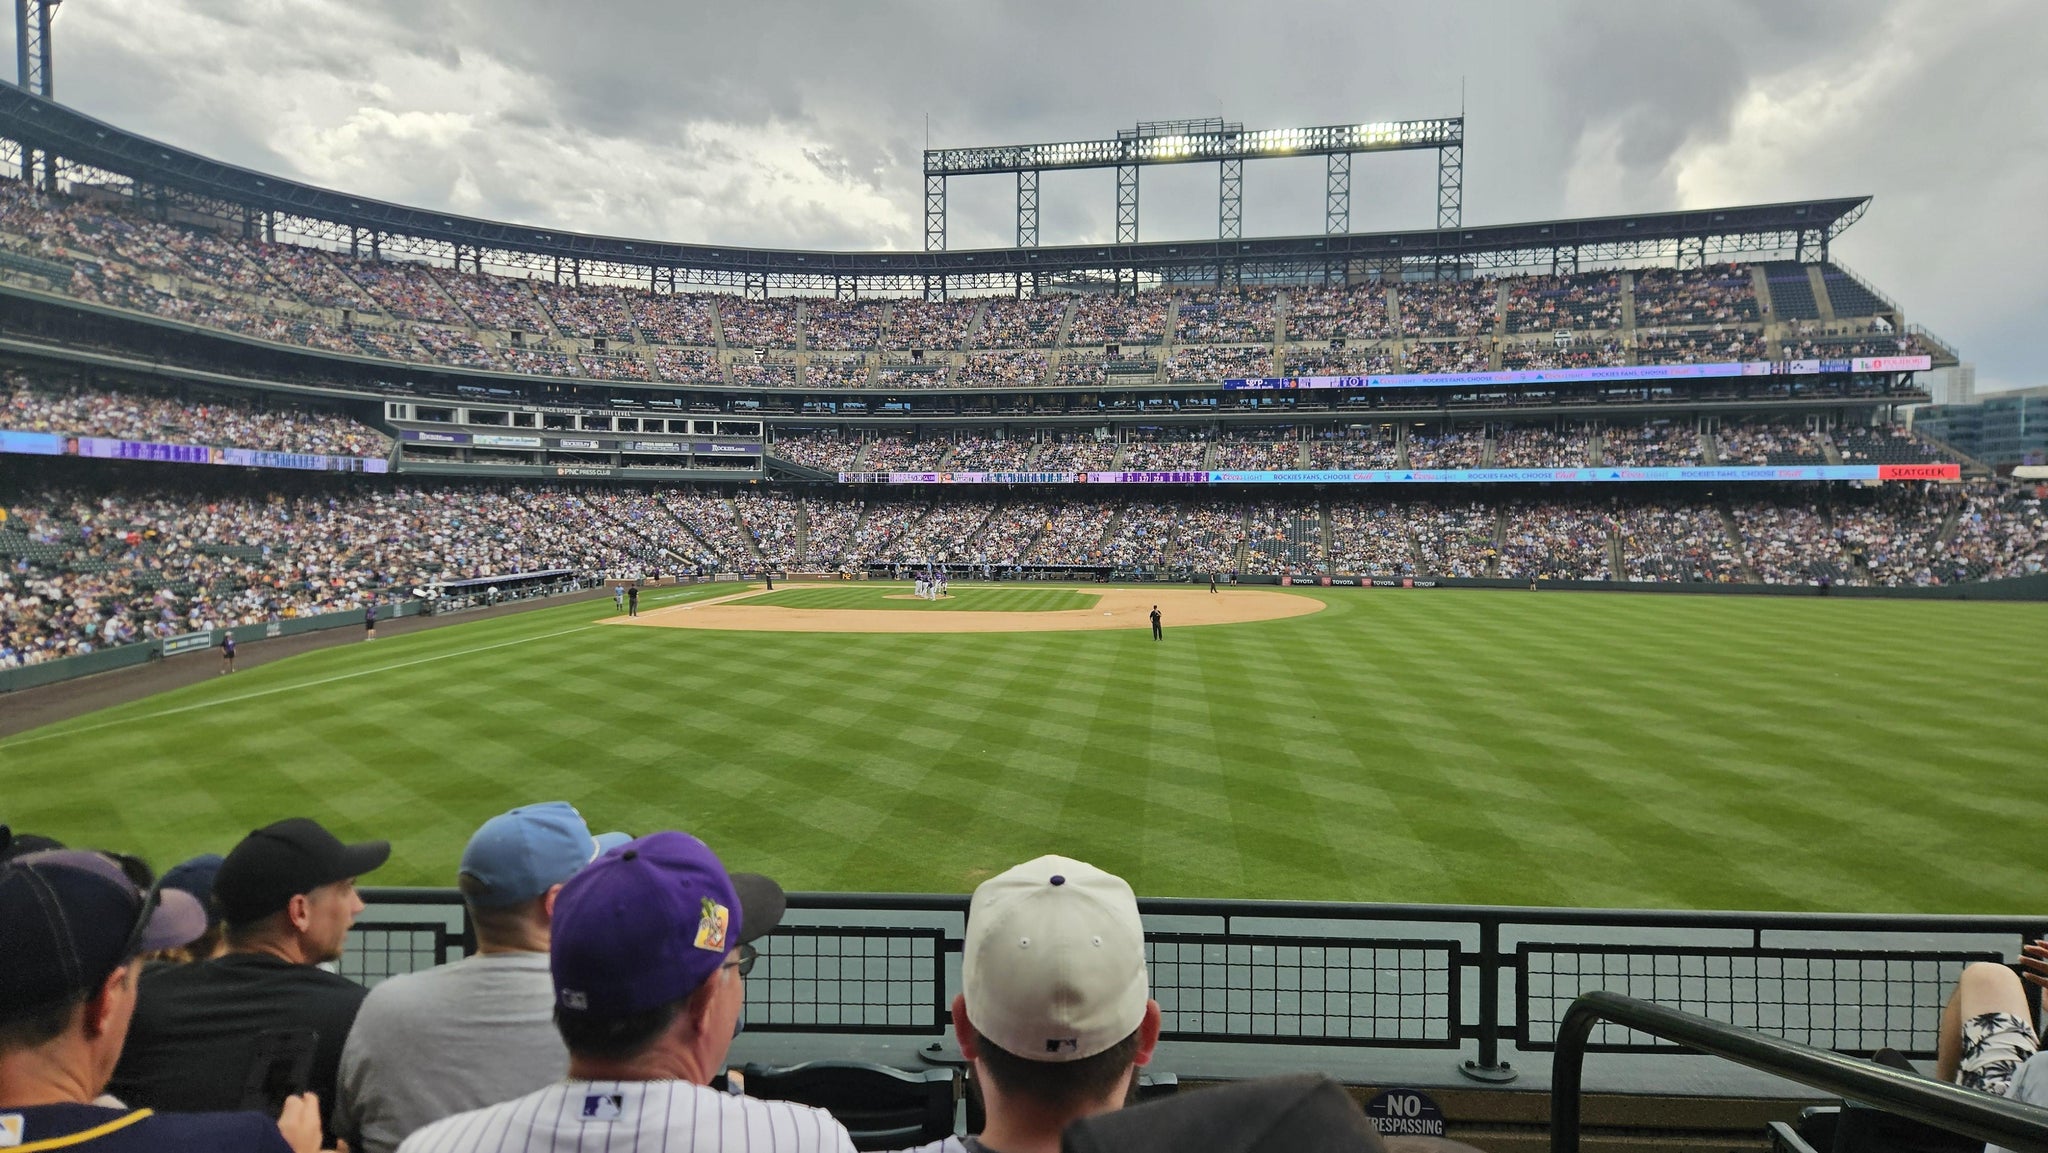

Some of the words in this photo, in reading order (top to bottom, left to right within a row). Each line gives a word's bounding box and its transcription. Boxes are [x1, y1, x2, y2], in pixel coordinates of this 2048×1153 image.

[1413, 472, 1434, 480] Coors
[1892, 468, 1945, 477] SEATGEEK
[1387, 1094, 1421, 1117] NO
